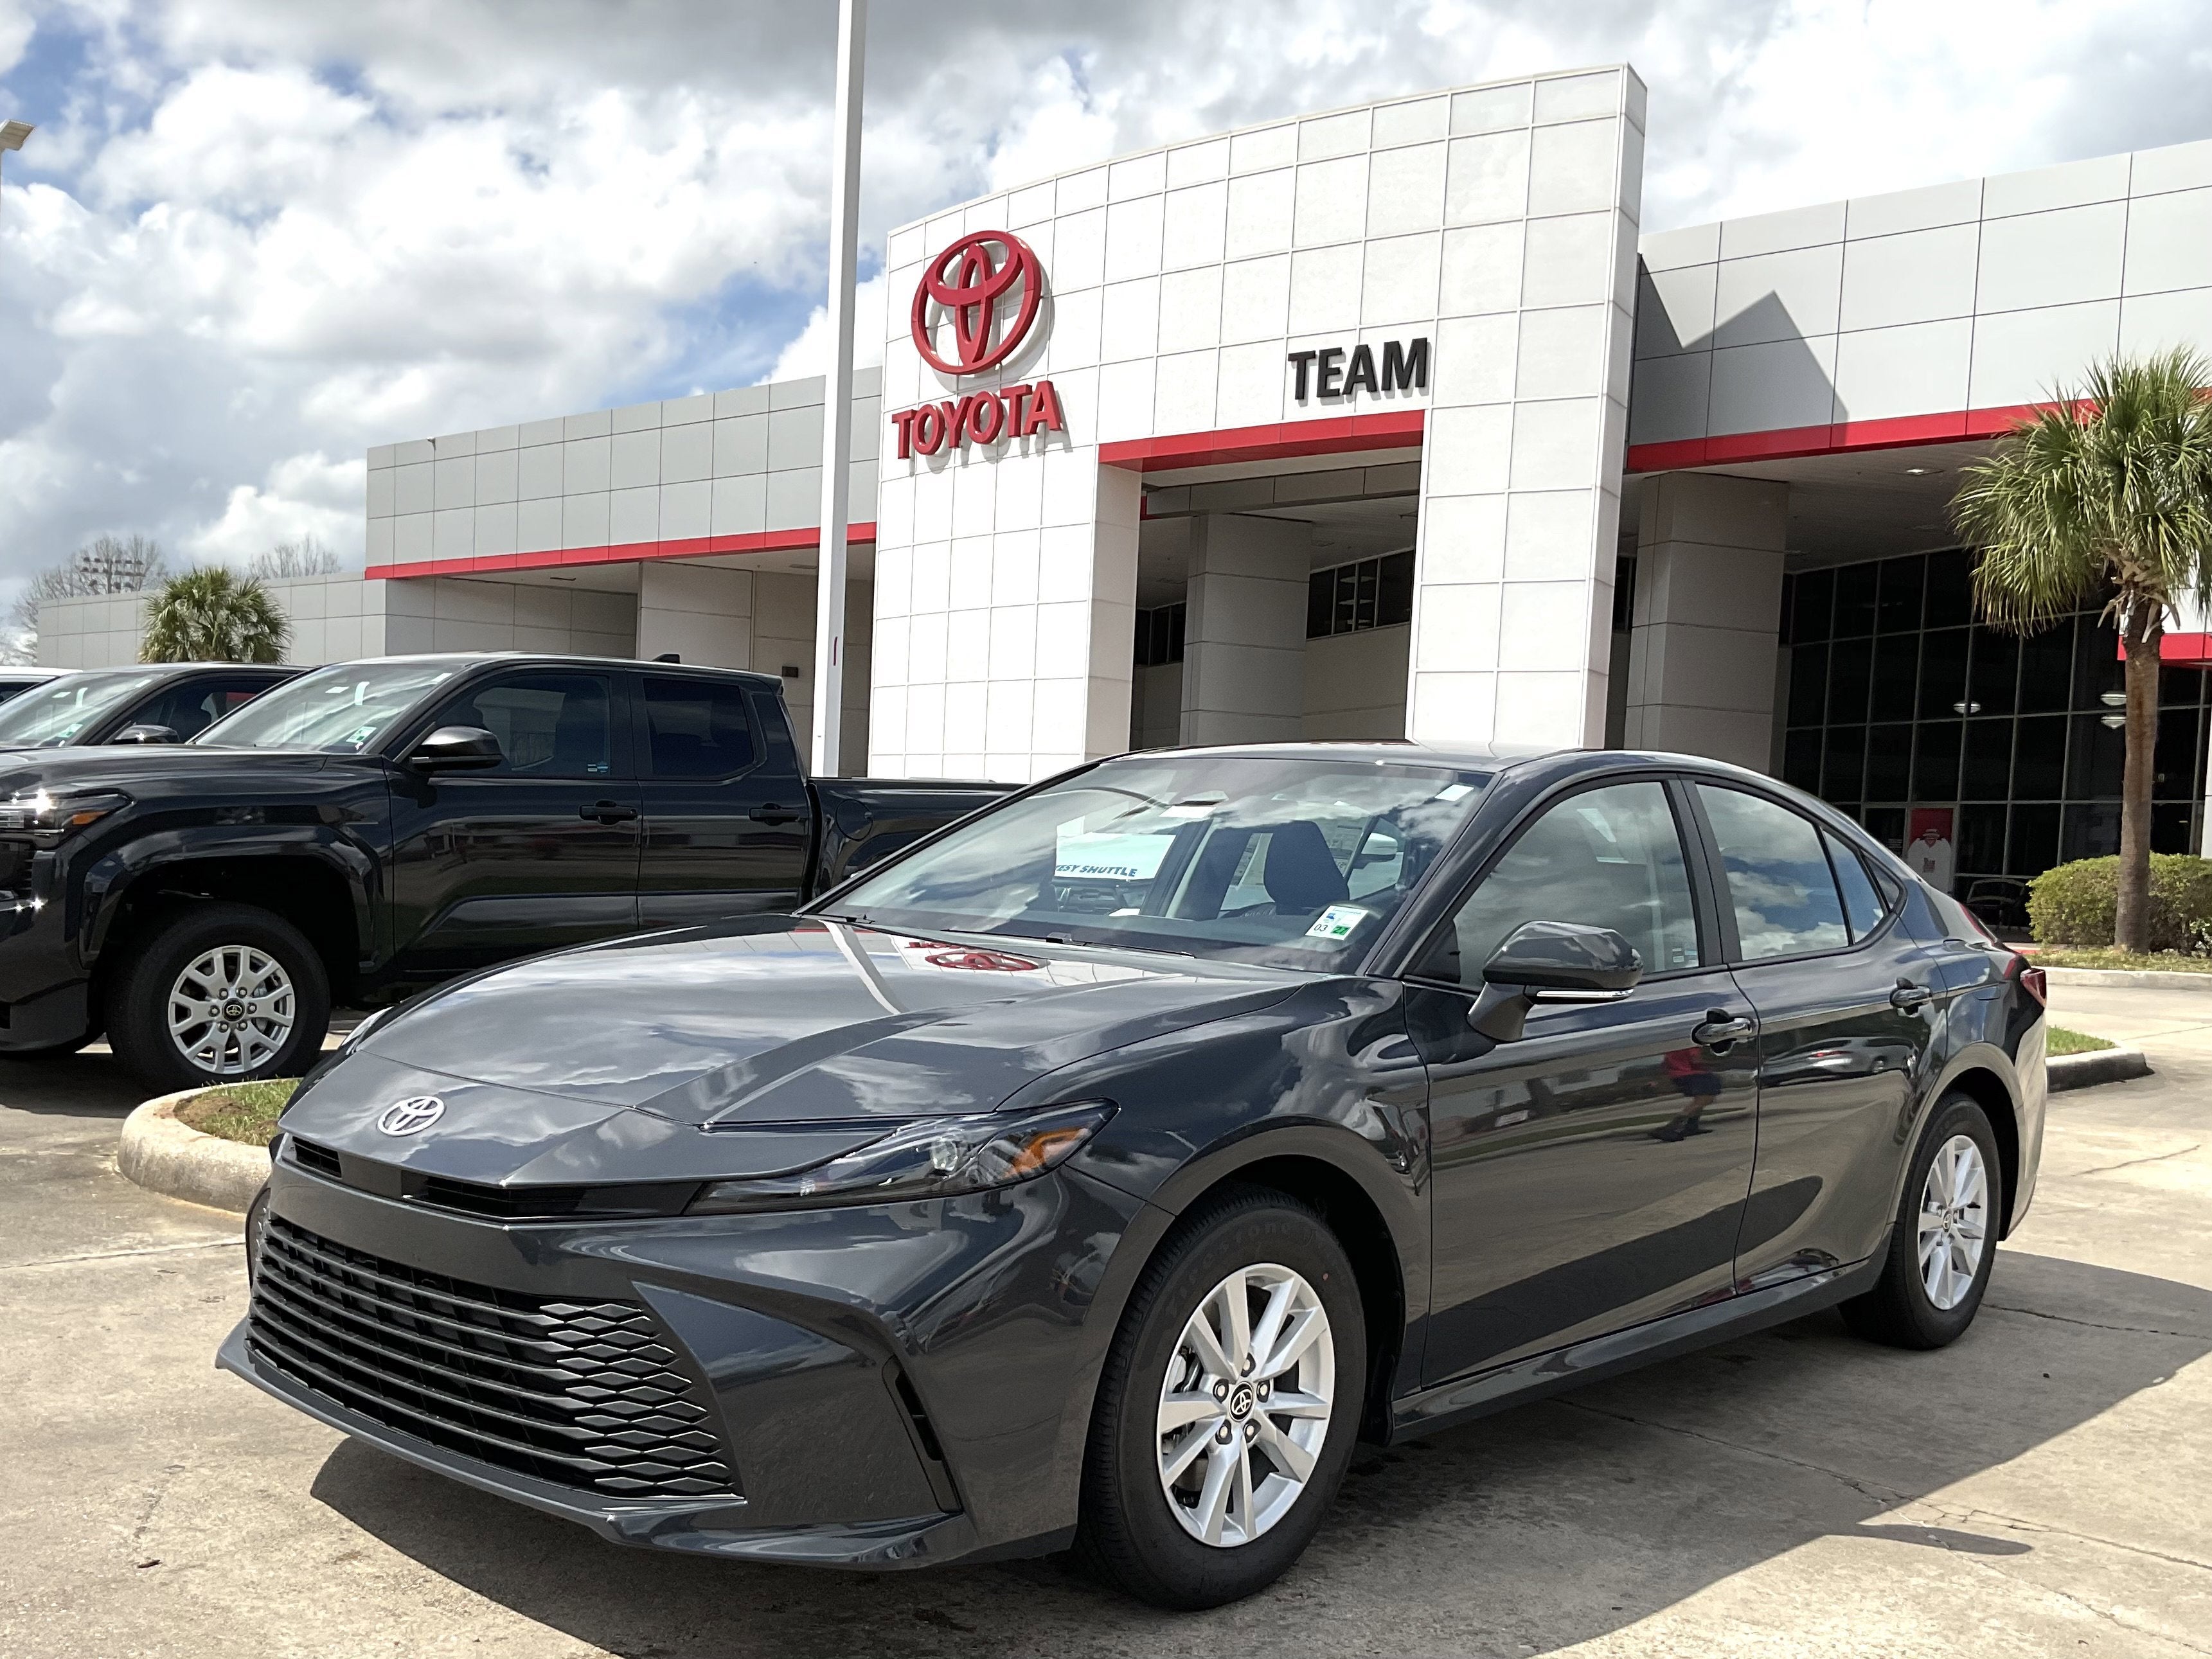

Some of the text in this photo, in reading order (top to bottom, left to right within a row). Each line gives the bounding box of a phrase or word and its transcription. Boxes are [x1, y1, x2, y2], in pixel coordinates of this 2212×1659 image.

[1287, 337, 1428, 400] TEAM
[891, 380, 1062, 459] TOYOTA
[1080, 865, 1138, 878] SHUTTLE
[1332, 926, 1349, 935] 27
